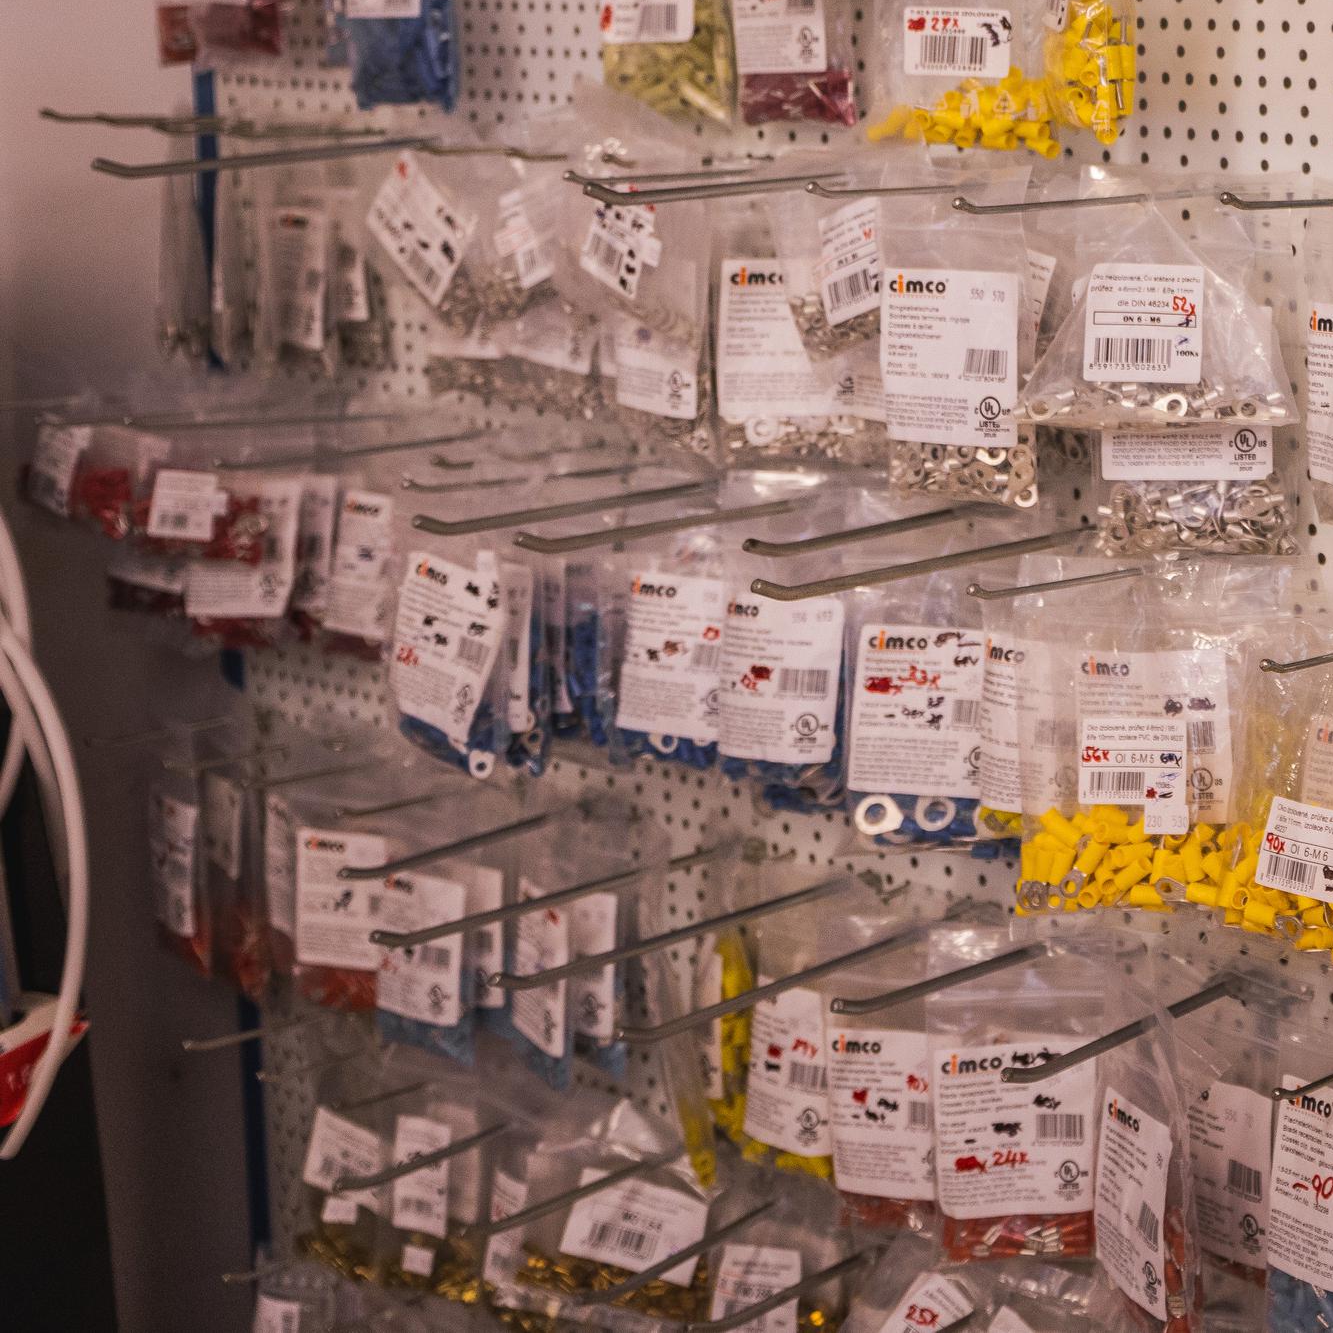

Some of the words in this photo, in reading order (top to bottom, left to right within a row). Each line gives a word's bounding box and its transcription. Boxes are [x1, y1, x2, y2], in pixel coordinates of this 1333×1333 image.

[889, 274, 947, 294] cimco
[1131, 300, 1147, 308] DIN
[1234, 453, 1257, 461] LISTED
[868, 630, 928, 652] cimco
[1080, 655, 1130, 677] cimco
[831, 1035, 882, 1055] cimco
[941, 1055, 1003, 1075] cimco
[1107, 1098, 1139, 1132] cimco
